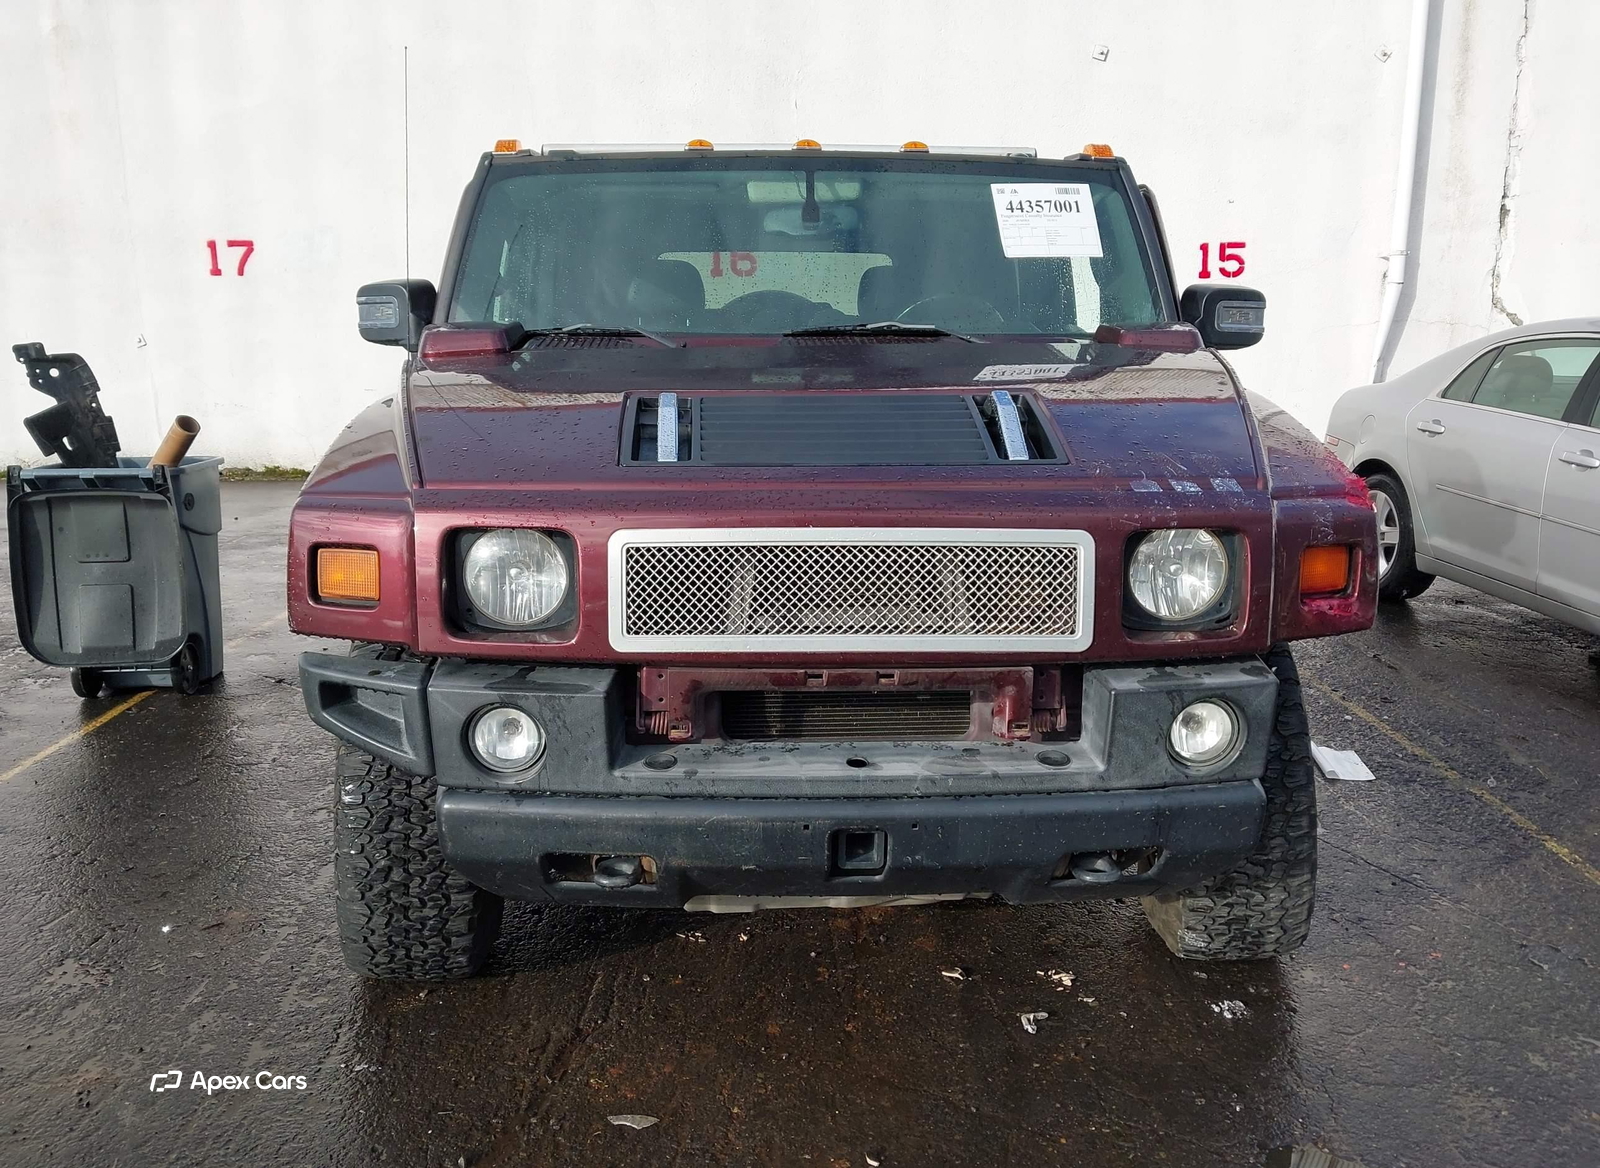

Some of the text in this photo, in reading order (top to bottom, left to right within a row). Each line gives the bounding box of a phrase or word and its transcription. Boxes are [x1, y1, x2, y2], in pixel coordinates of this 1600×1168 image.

[1005, 199, 1082, 214] 44357001
[207, 240, 254, 276] 17
[710, 252, 758, 277] 16
[1198, 242, 1246, 279] 15
